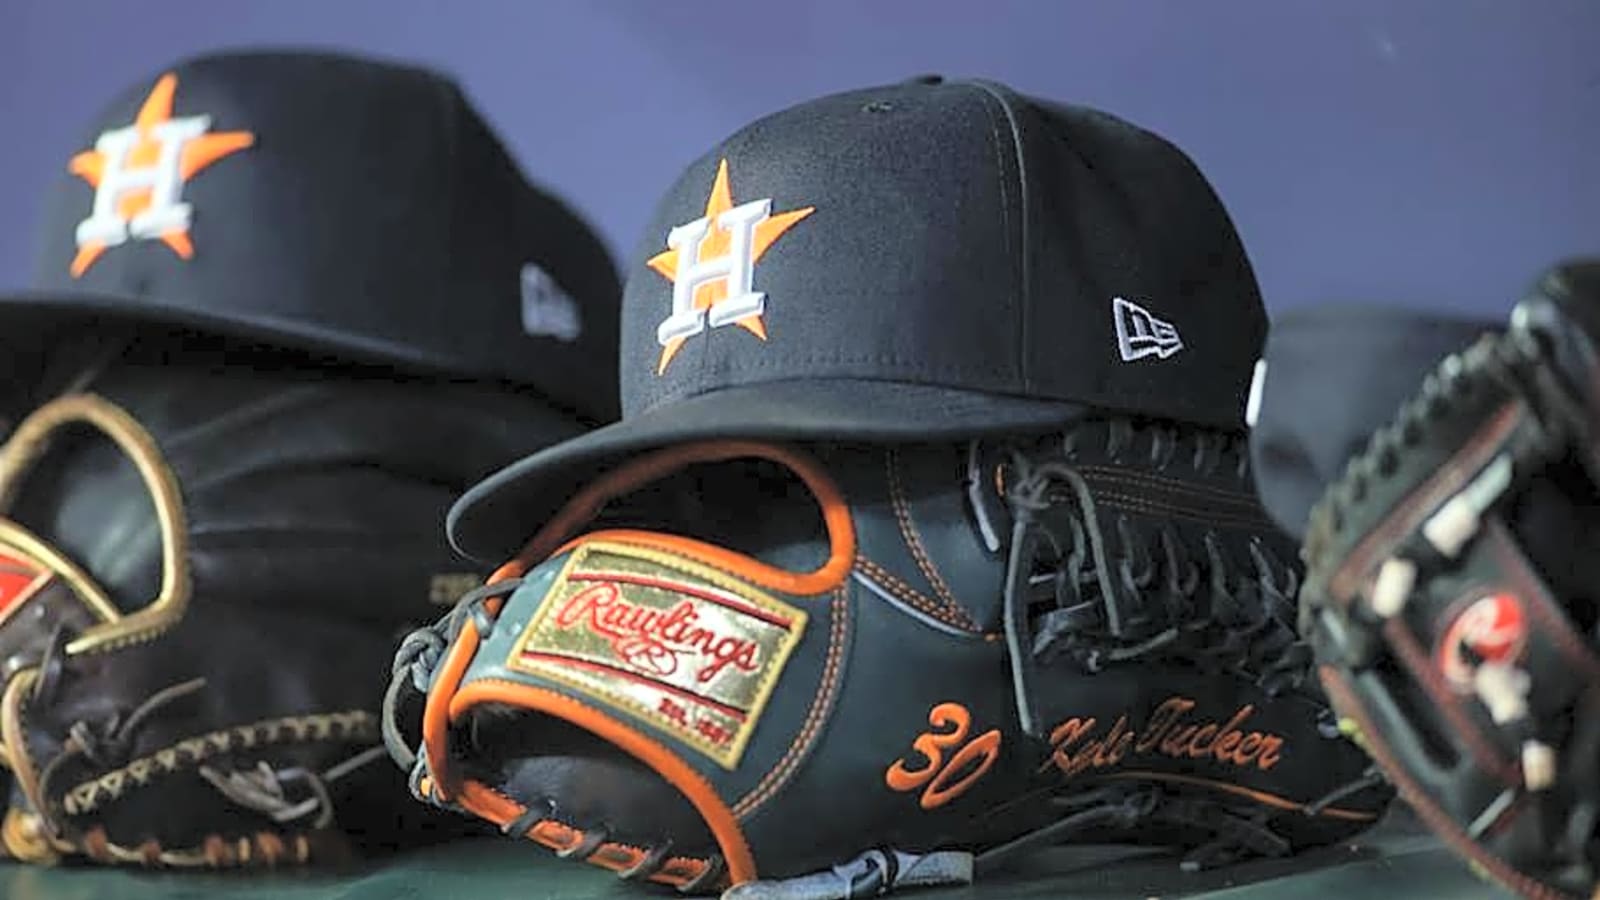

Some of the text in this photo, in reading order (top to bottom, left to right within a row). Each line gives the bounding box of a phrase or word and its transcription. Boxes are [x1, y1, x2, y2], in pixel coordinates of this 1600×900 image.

[76, 114, 212, 248] H
[657, 198, 773, 346] H
[555, 581, 760, 683] Rawlings
[886, 702, 1001, 809] 30
[1136, 697, 1284, 770] Tucker
